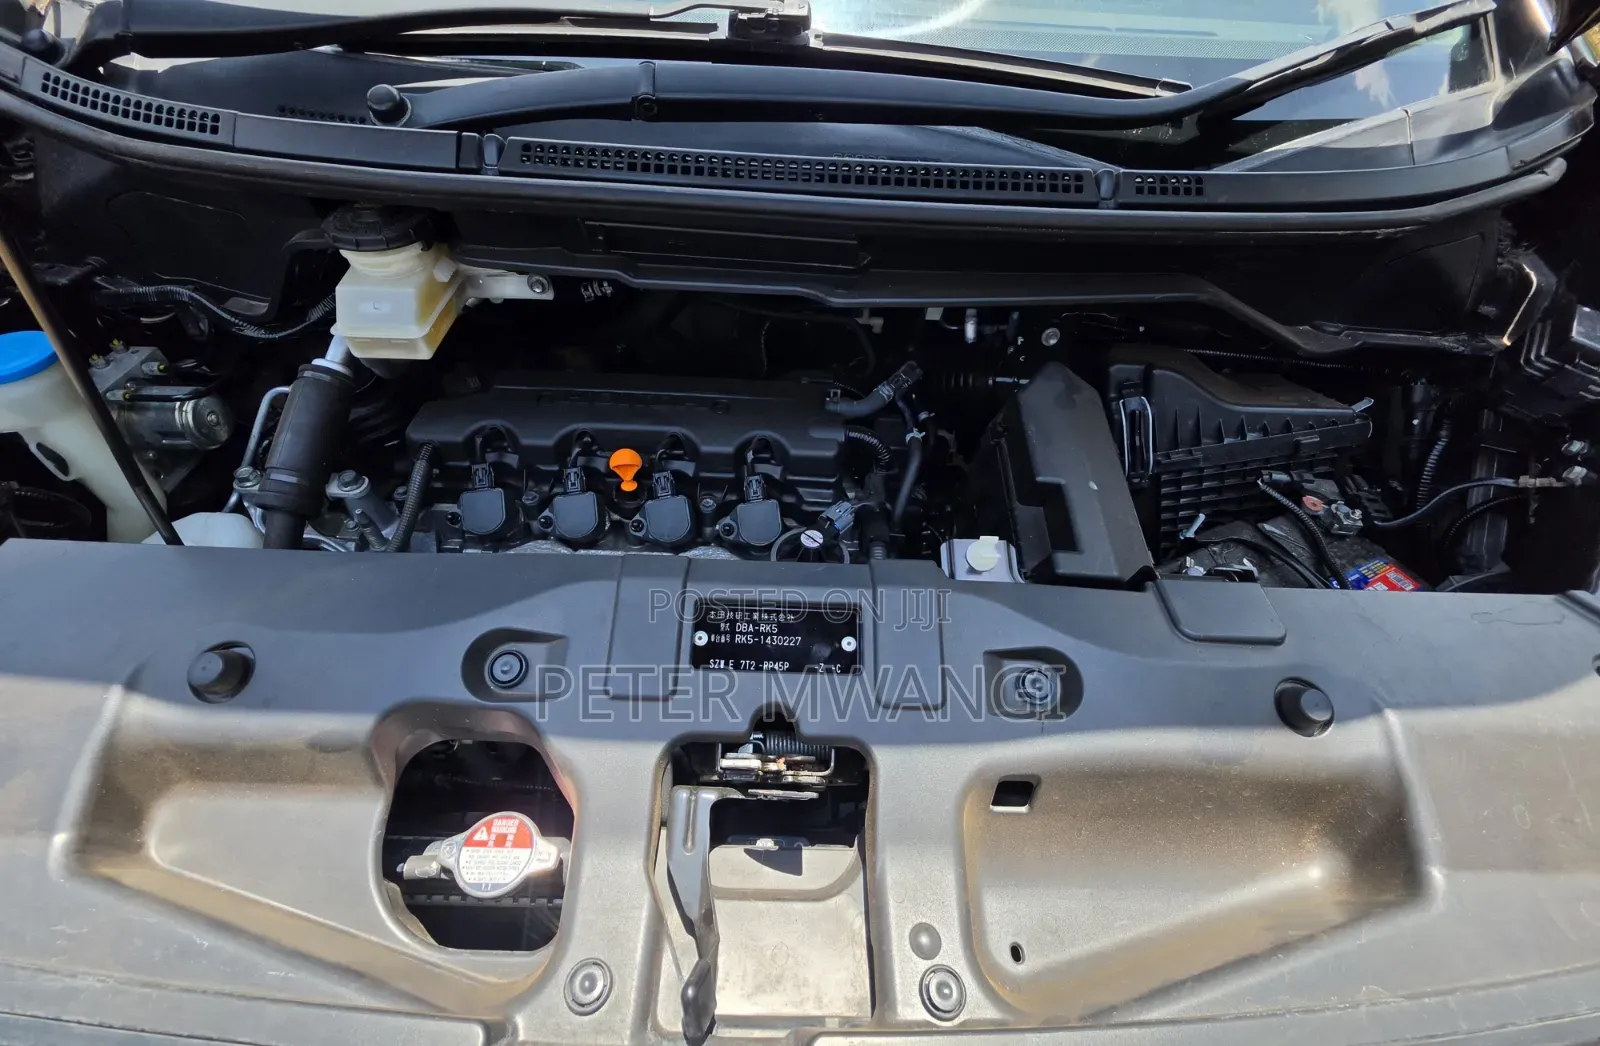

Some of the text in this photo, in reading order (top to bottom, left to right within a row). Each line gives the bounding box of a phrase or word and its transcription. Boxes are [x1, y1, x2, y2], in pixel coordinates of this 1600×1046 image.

[735, 623, 778, 634] DBA-RK5
[735, 634, 802, 646] RK5-1430227
[728, 659, 734, 670] E
[740, 660, 756, 670] 7T2
